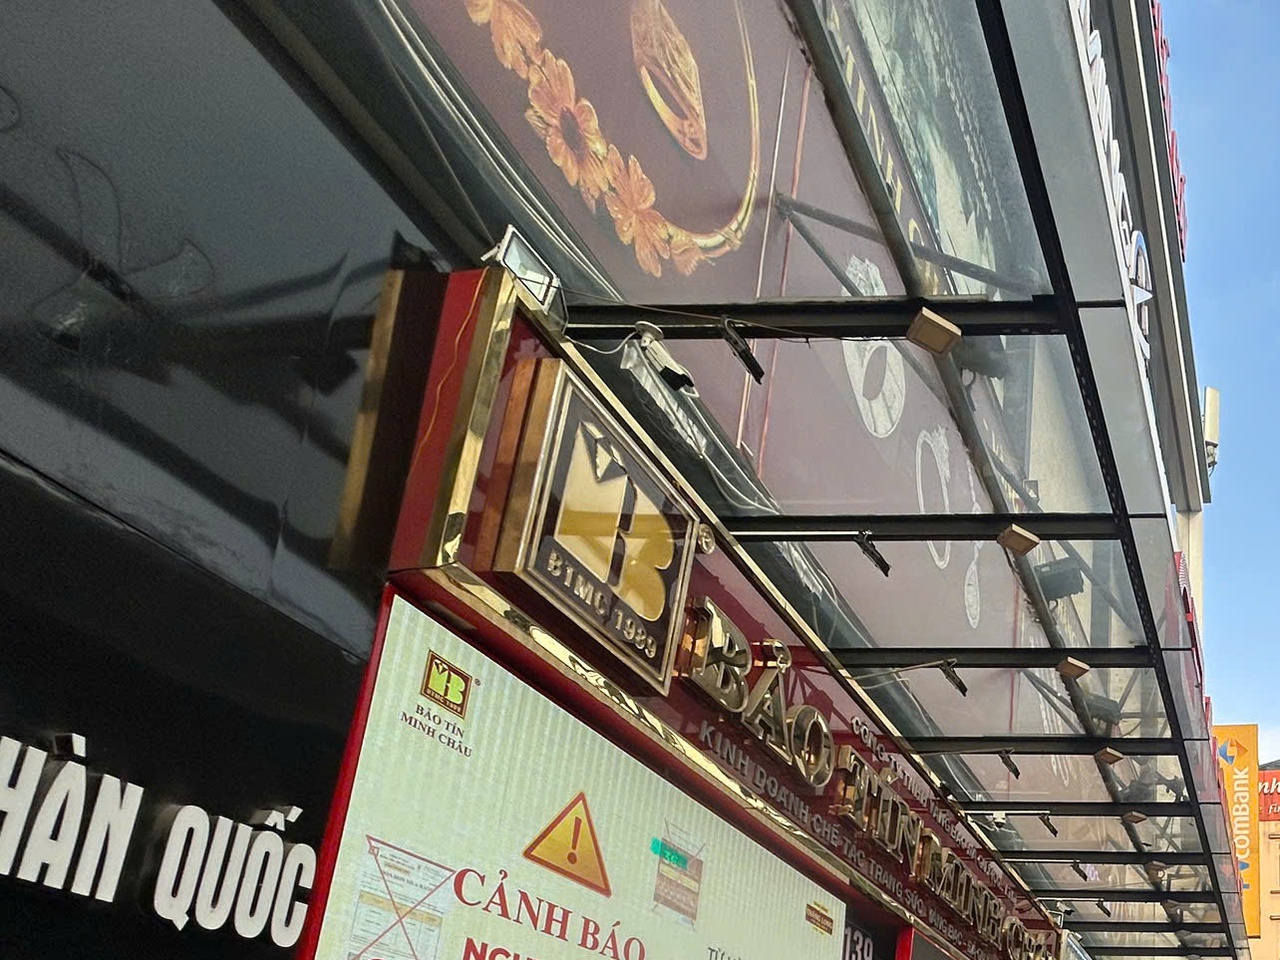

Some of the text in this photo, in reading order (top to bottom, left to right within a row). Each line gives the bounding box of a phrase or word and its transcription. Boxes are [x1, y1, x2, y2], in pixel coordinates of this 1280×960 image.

[613, 608, 657, 658] 1989
[400, 711, 472, 757] MINH CHÂU
[415, 703, 465, 738] BẢO TÍN
[691, 596, 836, 788] BẢO
[840, 745, 924, 878] TÍN
[925, 830, 1004, 952] MINH
[699, 721, 750, 777] KINH
[753, 767, 810, 825] DOANH
[811, 814, 841, 848] CHẾ
[842, 836, 866, 868] TÁC
[868, 858, 904, 899] TRANG
[0, 733, 317, 948] HÀN QUỐC
[1233, 765, 1250, 889] VcomBank
[453, 869, 573, 942] CẢNH
